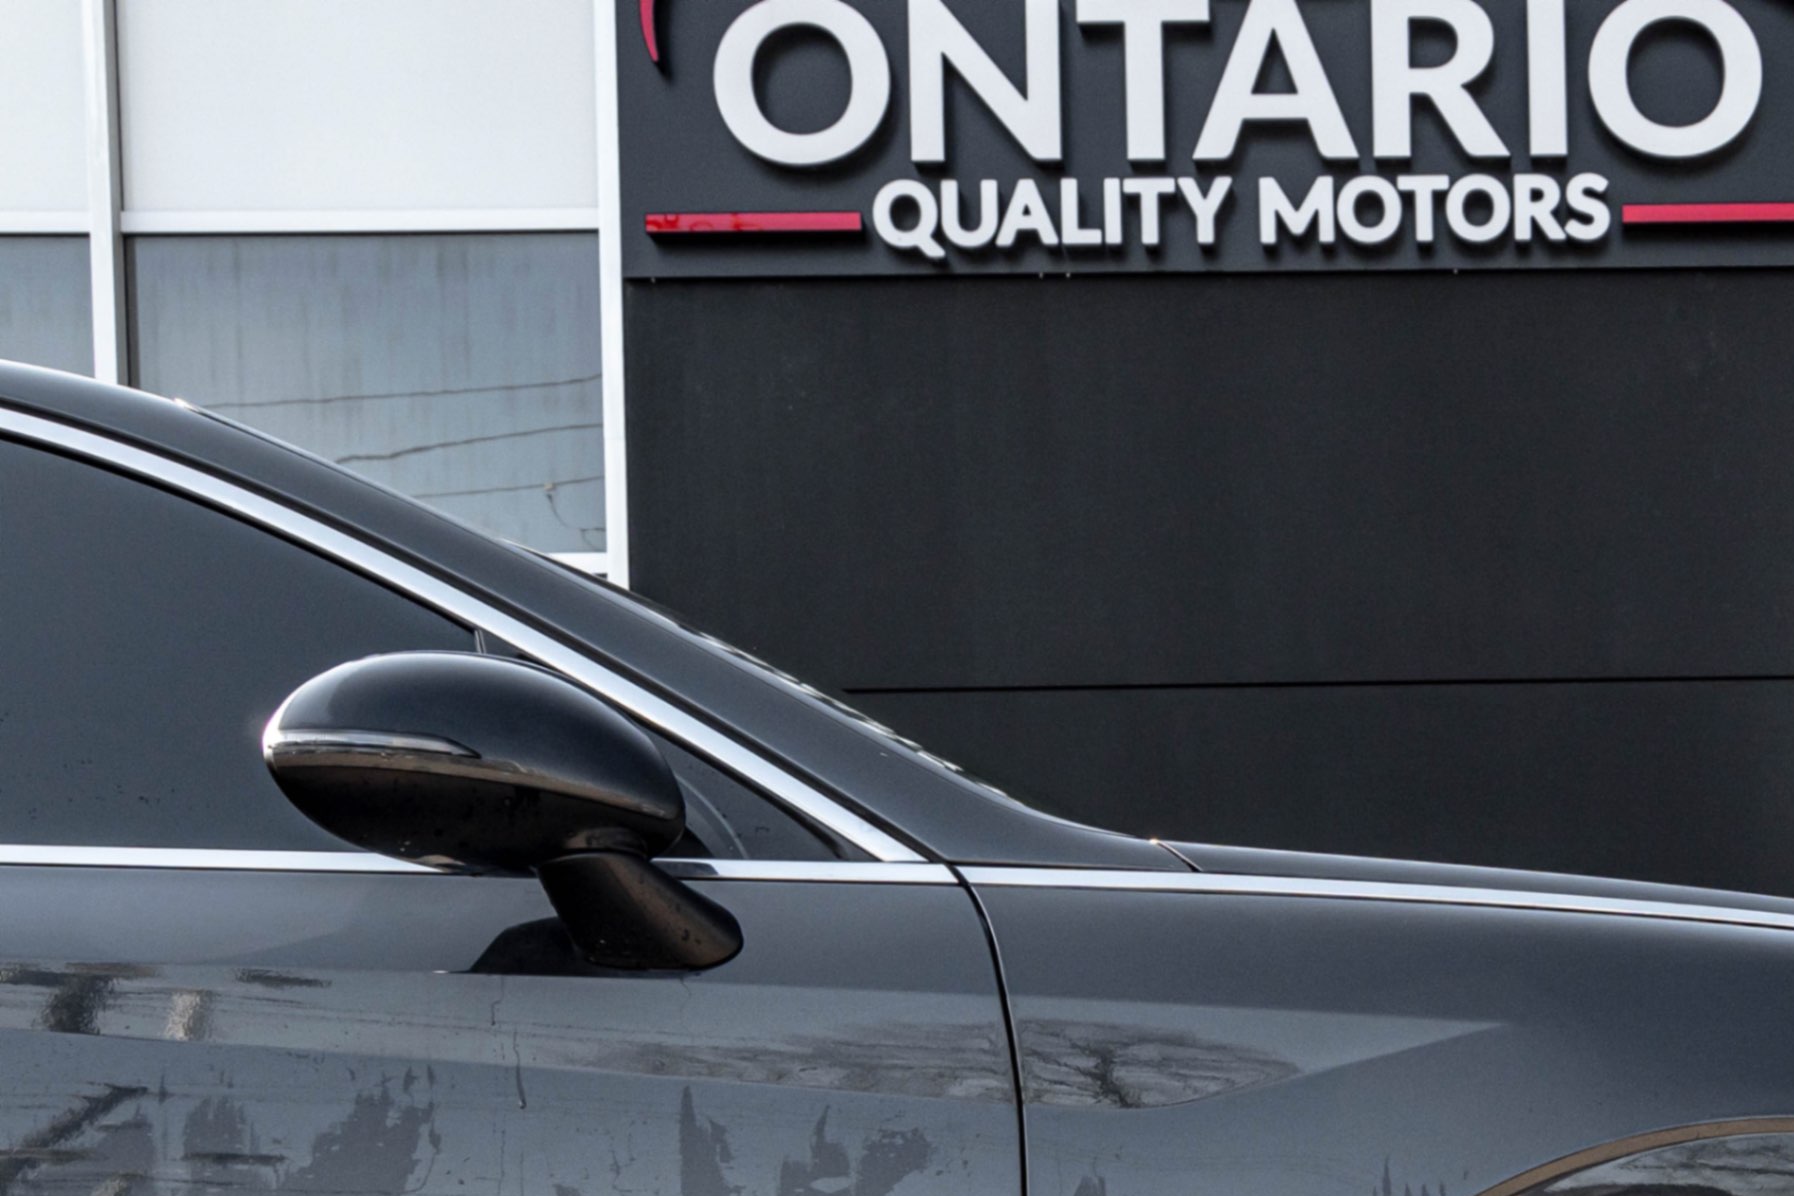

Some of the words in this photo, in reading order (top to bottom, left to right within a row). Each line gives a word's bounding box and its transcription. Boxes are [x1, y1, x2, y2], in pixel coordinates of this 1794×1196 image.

[713, 0, 1763, 165] ONTARIO
[872, 176, 1232, 258] QUALITY
[1258, 172, 1611, 244] MOTORS
